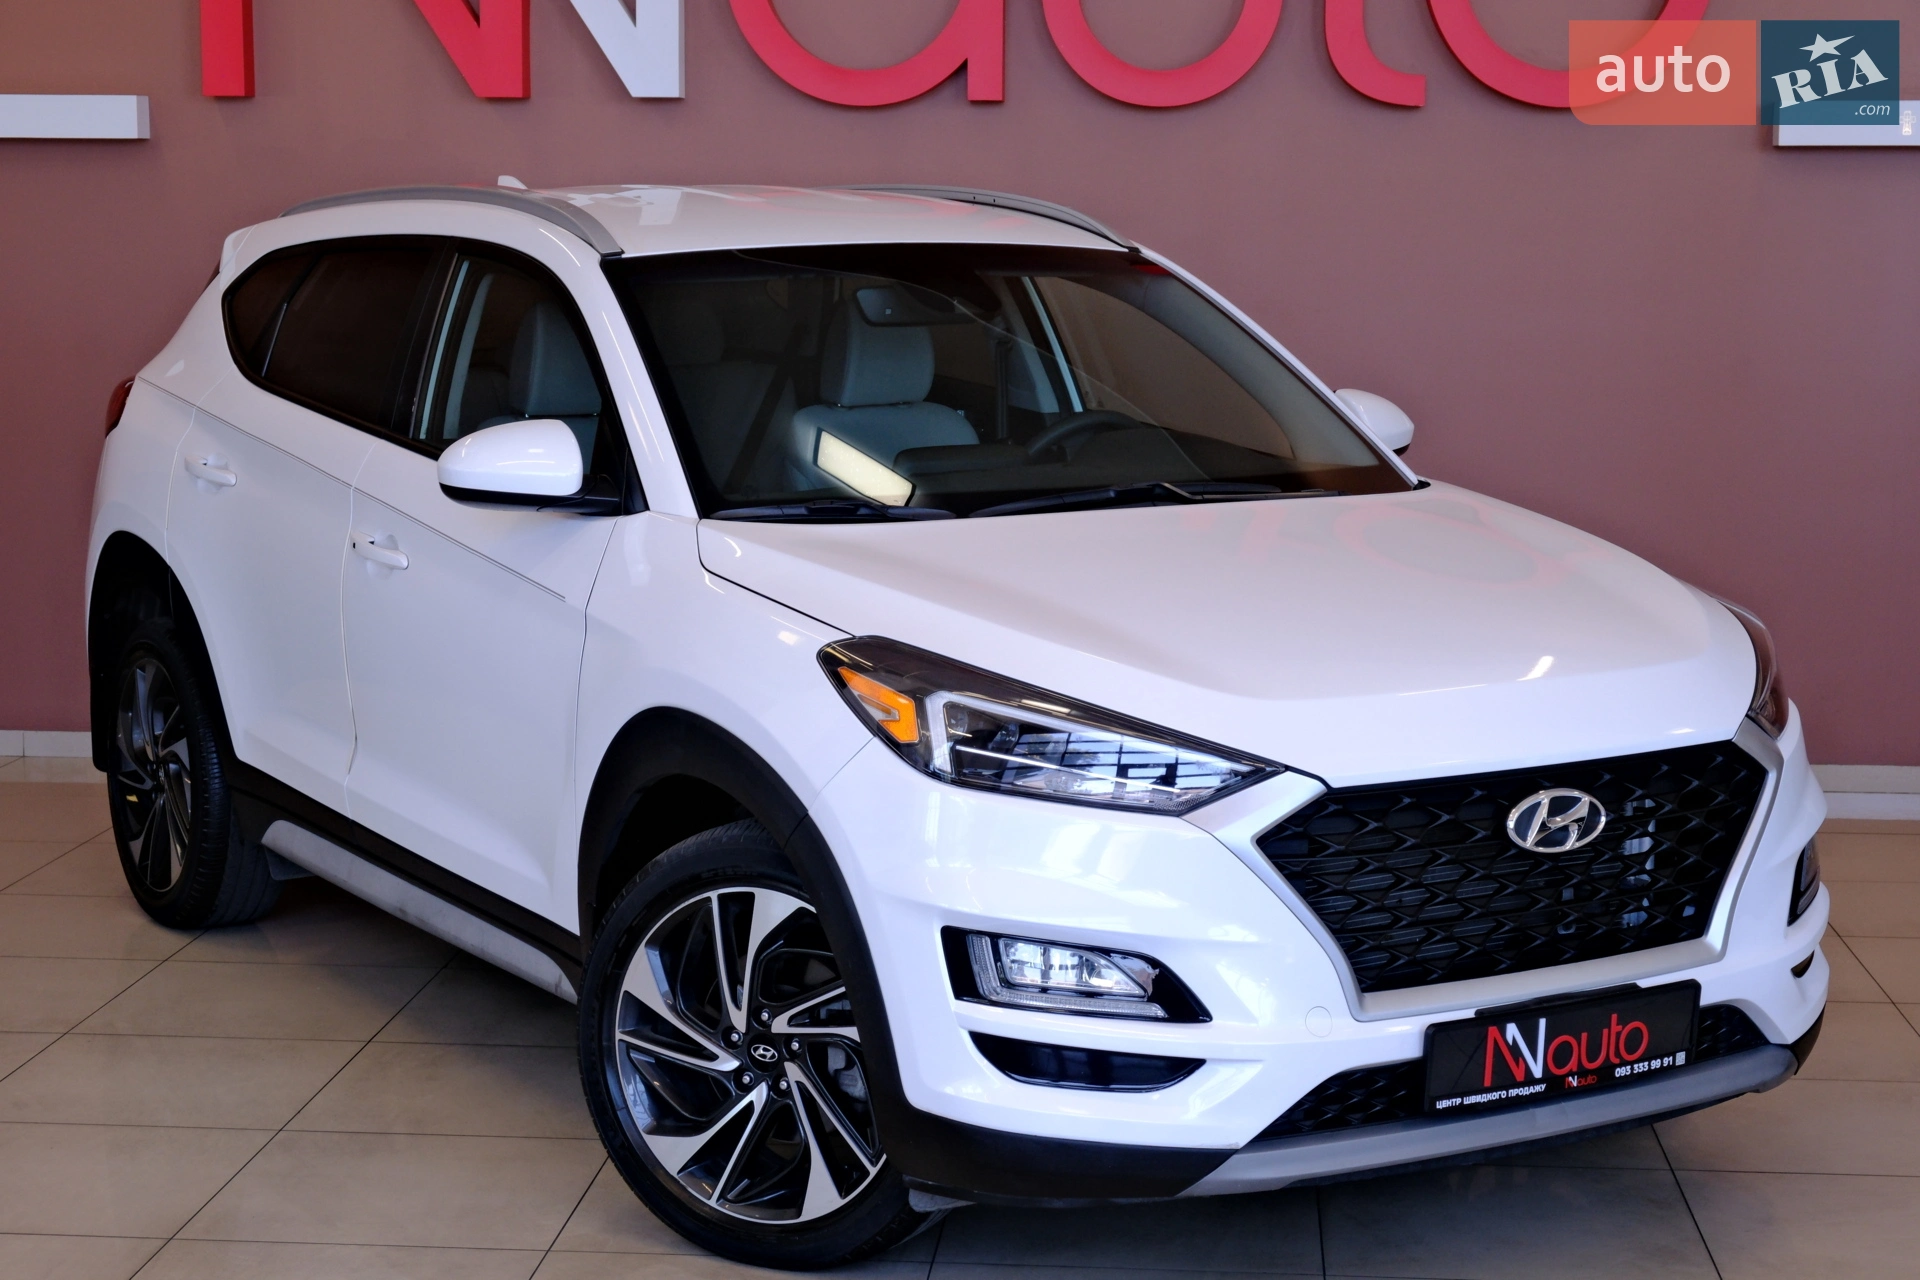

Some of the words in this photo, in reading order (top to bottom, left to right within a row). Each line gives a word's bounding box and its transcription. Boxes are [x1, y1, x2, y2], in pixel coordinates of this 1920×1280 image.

[1615, 1065, 1631, 1077] 093
[1633, 1061, 1649, 1073] 333
[1650, 1059, 1661, 1069] 99
[1663, 1056, 1673, 1067] 91
[1436, 1097, 1462, 1109] ЦЕНТР
[1463, 1090, 1507, 1104] ШВИДКОГО
[1508, 1083, 1546, 1097] ПРОДАЖУ
